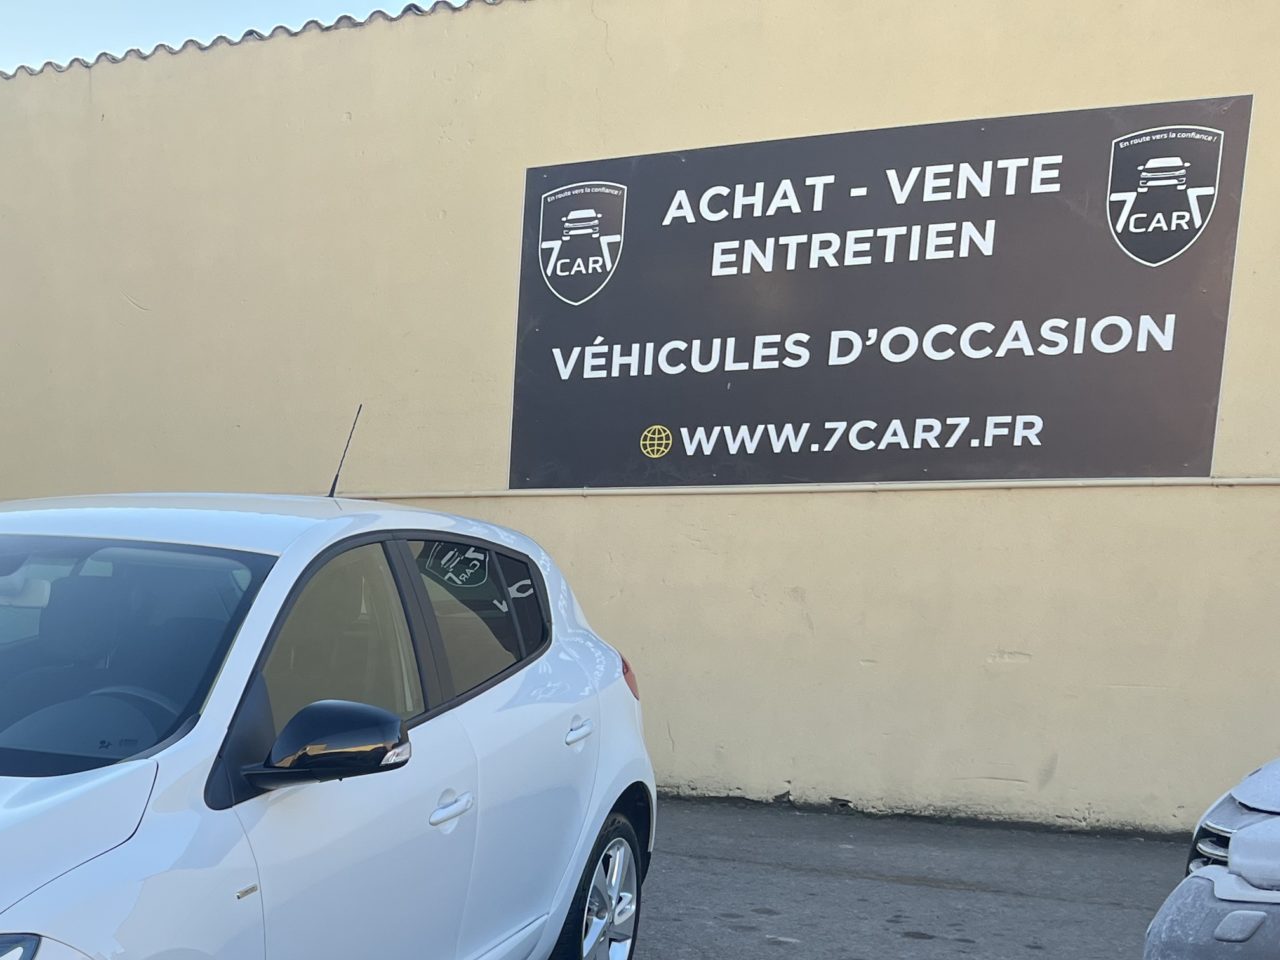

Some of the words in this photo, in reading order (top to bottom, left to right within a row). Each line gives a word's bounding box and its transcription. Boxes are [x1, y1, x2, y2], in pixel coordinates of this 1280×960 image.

[1119, 141, 1130, 149] En
[1130, 135, 1151, 145] route
[1151, 132, 1168, 141] vers
[661, 174, 835, 226] ACHAT
[886, 154, 1063, 205] VENTE
[711, 219, 996, 276] ENTRETIEN
[552, 332, 810, 381] VÉHICULES
[828, 313, 1176, 366] D’OCCASION
[680, 414, 1045, 456] WWW.7CAR7.FR
